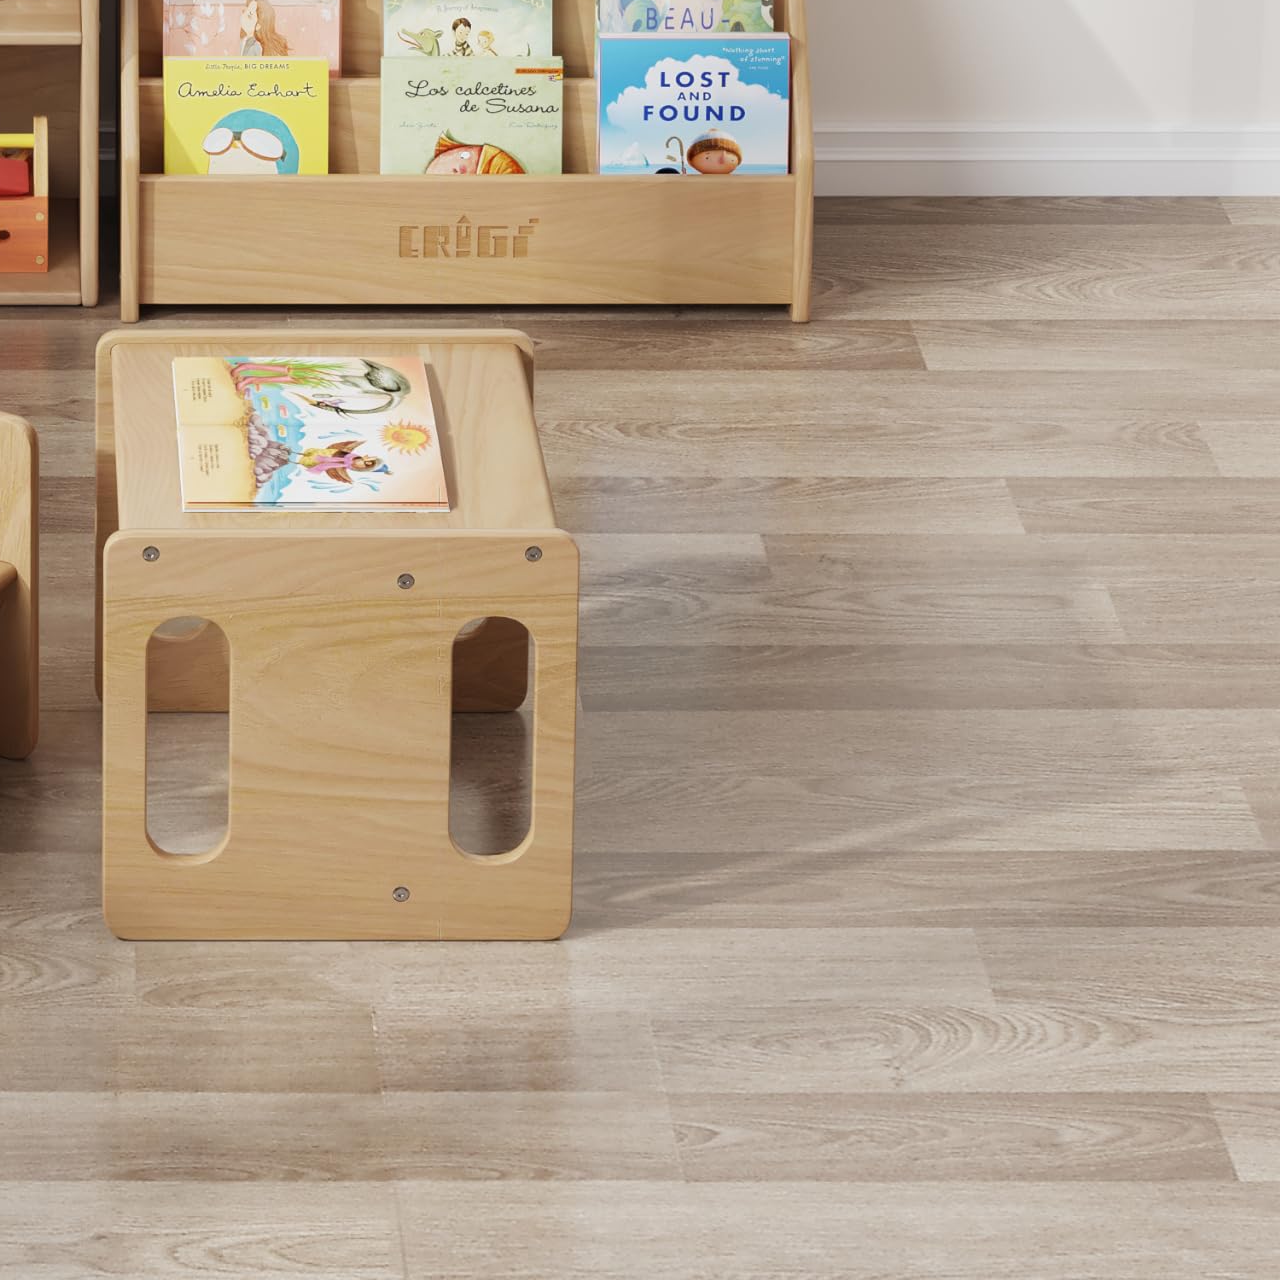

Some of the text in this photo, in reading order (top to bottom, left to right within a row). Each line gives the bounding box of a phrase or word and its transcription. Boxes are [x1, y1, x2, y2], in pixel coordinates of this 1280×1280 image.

[660, 71, 731, 88] LOST
[177, 81, 317, 98] Amelia Earhart
[405, 79, 538, 98] Los calcetines
[677, 91, 712, 101] AND
[459, 98, 559, 114] de Susana
[643, 105, 746, 122] FOUND
